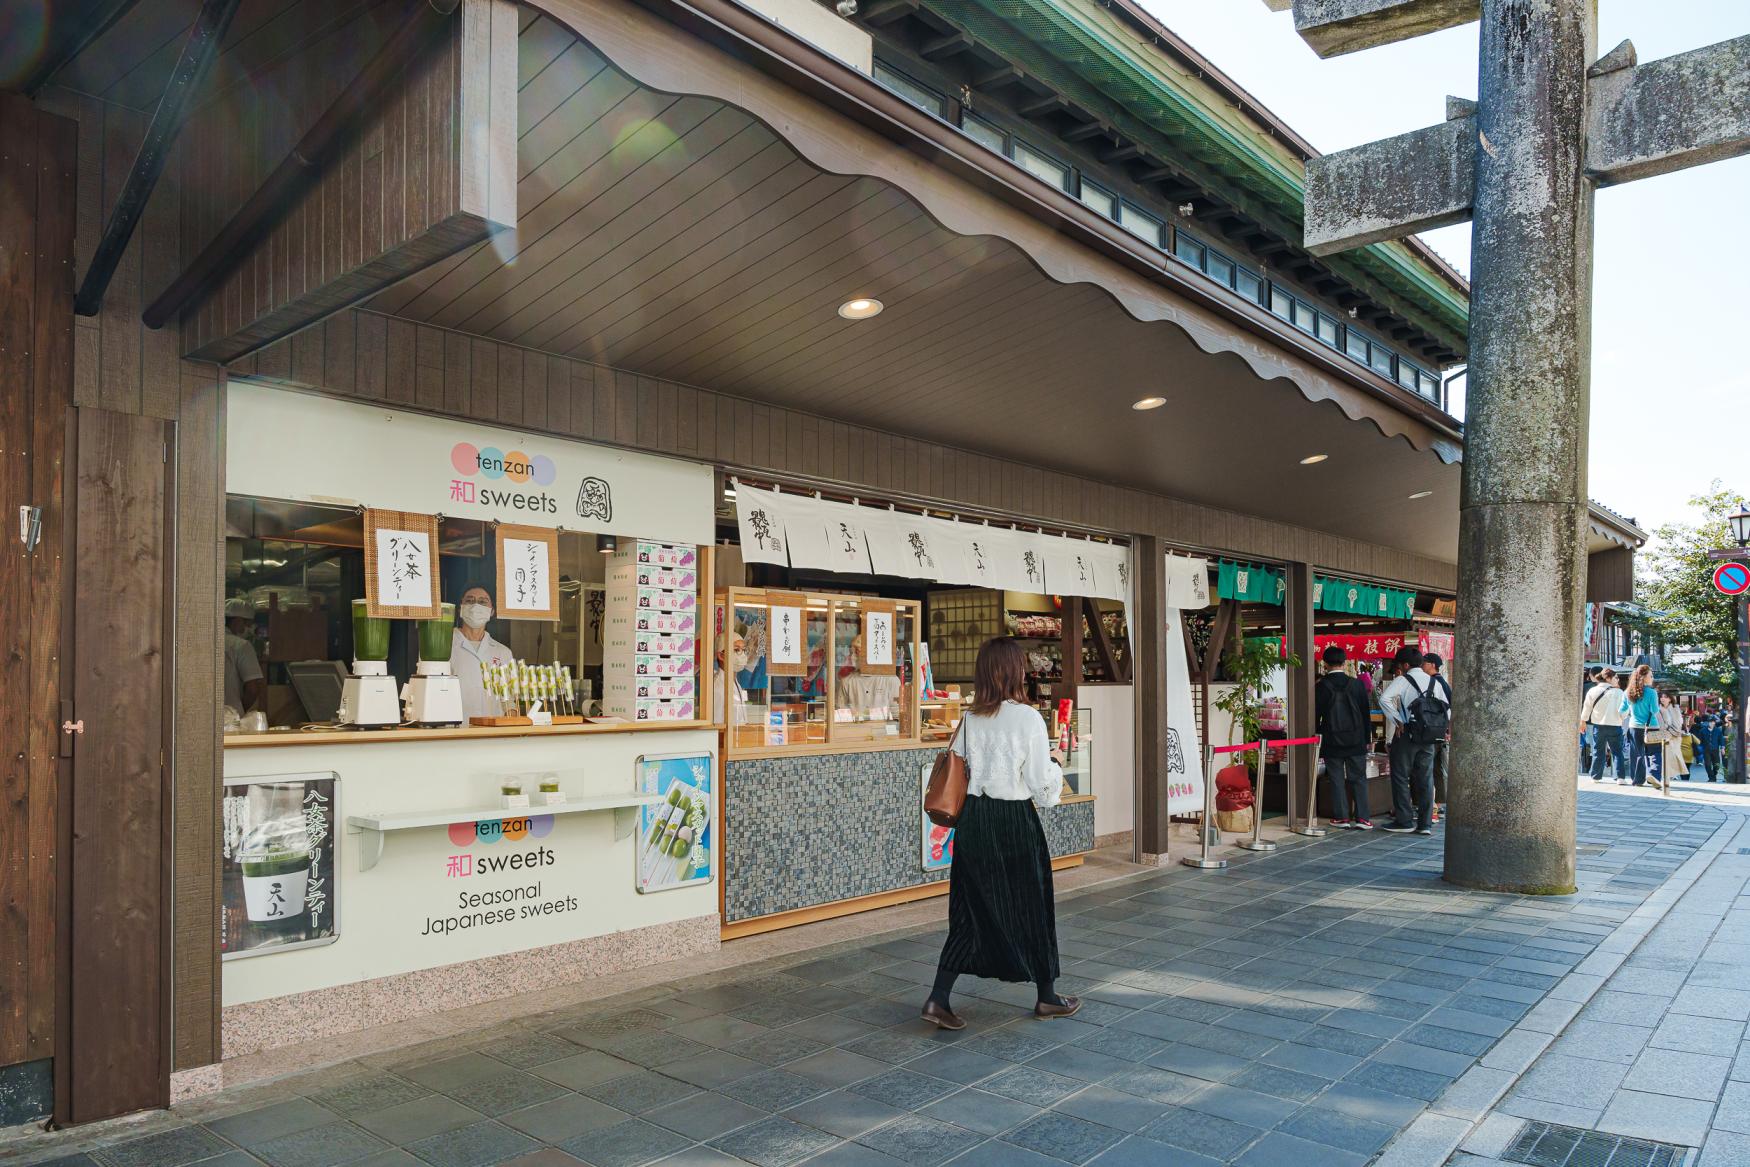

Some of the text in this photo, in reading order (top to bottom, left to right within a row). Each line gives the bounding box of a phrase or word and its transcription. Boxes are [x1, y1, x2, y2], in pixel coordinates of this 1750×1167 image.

[476, 453, 535, 476] tenzan
[450, 480, 557, 514] 和 sweets
[840, 522, 856, 553] 天山
[390, 537, 402, 600] グリーンティー
[403, 539, 422, 580] 八女茶
[972, 542, 985, 570] 天山
[515, 568, 526, 603] 団子
[527, 543, 539, 607] シャインマスカット
[474, 818, 533, 836] tenzan
[303, 789, 329, 928] 八女茶グリーンティー
[446, 846, 555, 878] 和 sweets
[267, 882, 286, 917] 天山
[458, 881, 541, 909] Seasonal
[421, 895, 578, 936] Japanese sweets
